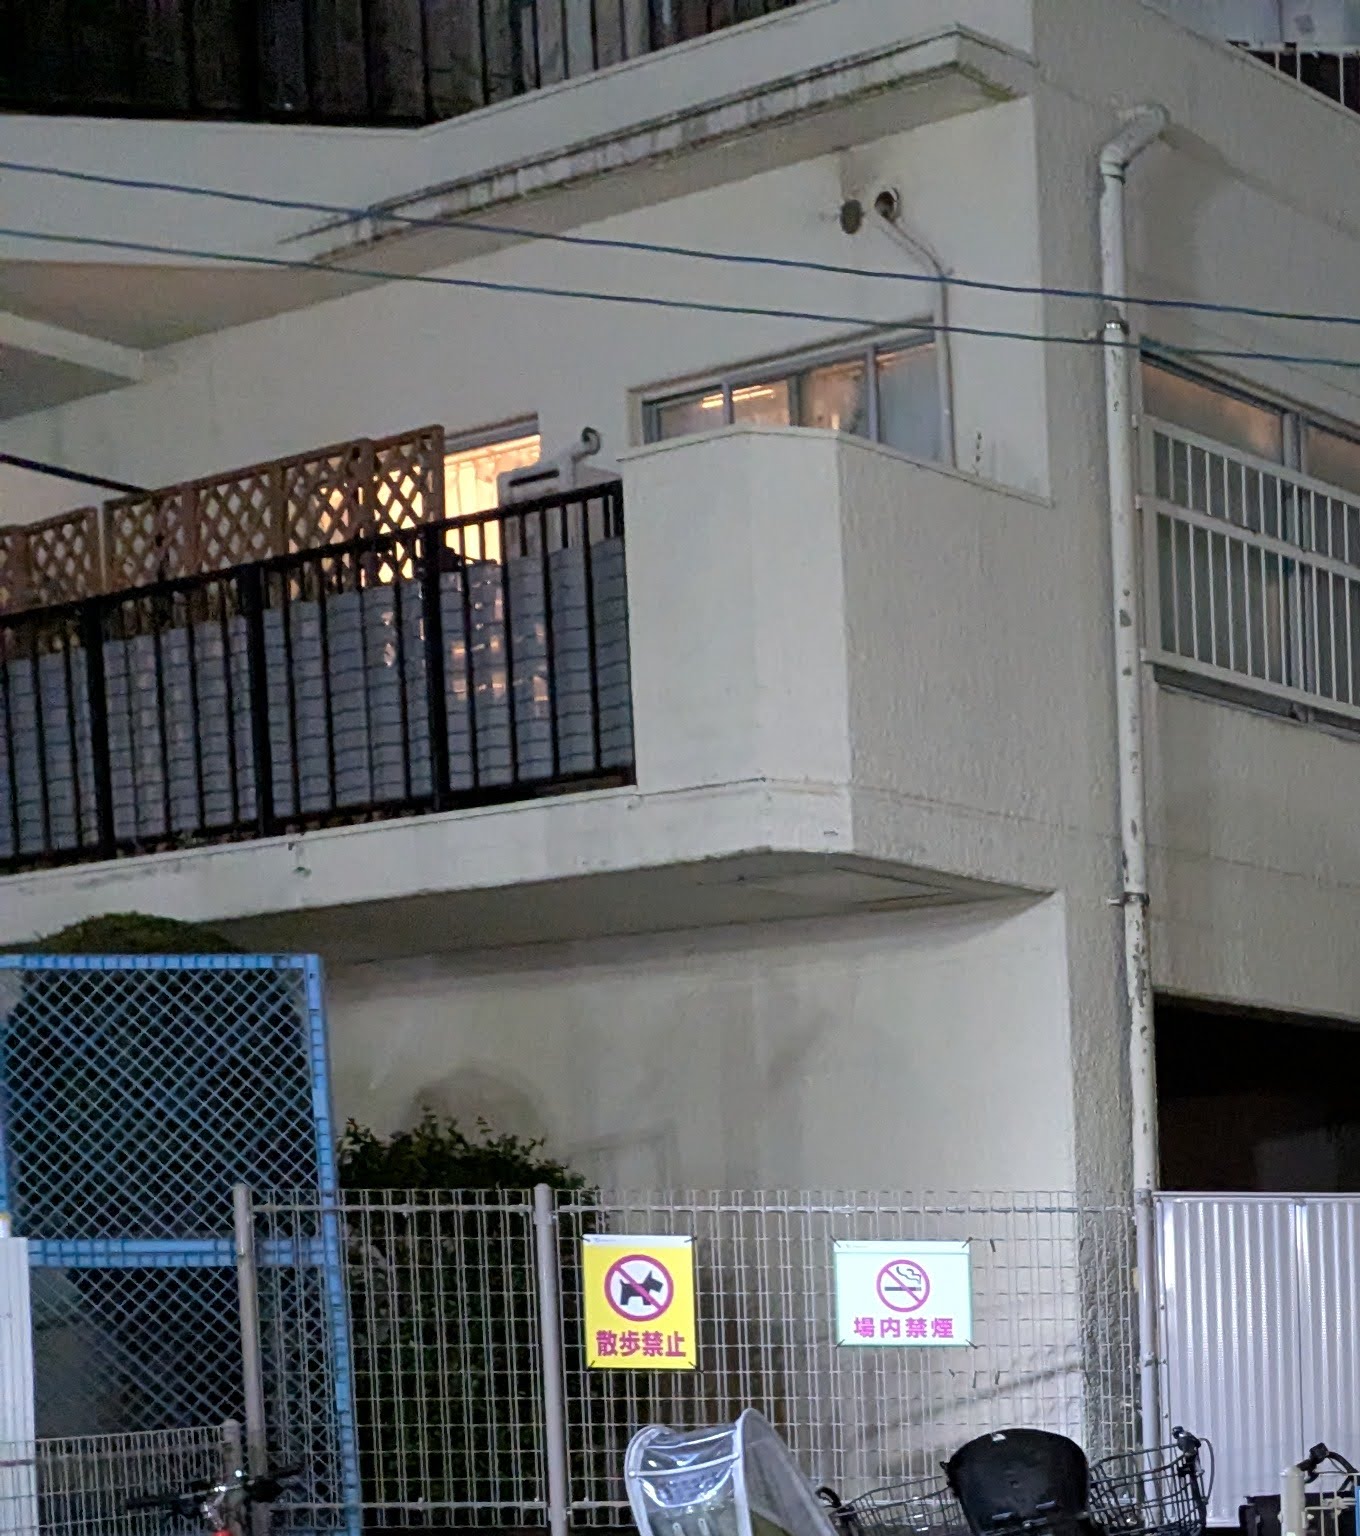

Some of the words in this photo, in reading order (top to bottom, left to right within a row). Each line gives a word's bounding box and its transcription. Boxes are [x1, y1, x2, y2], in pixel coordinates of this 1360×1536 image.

[853, 1317, 954, 1340] 場内禁煙
[596, 1330, 687, 1358] 散歩禁止
